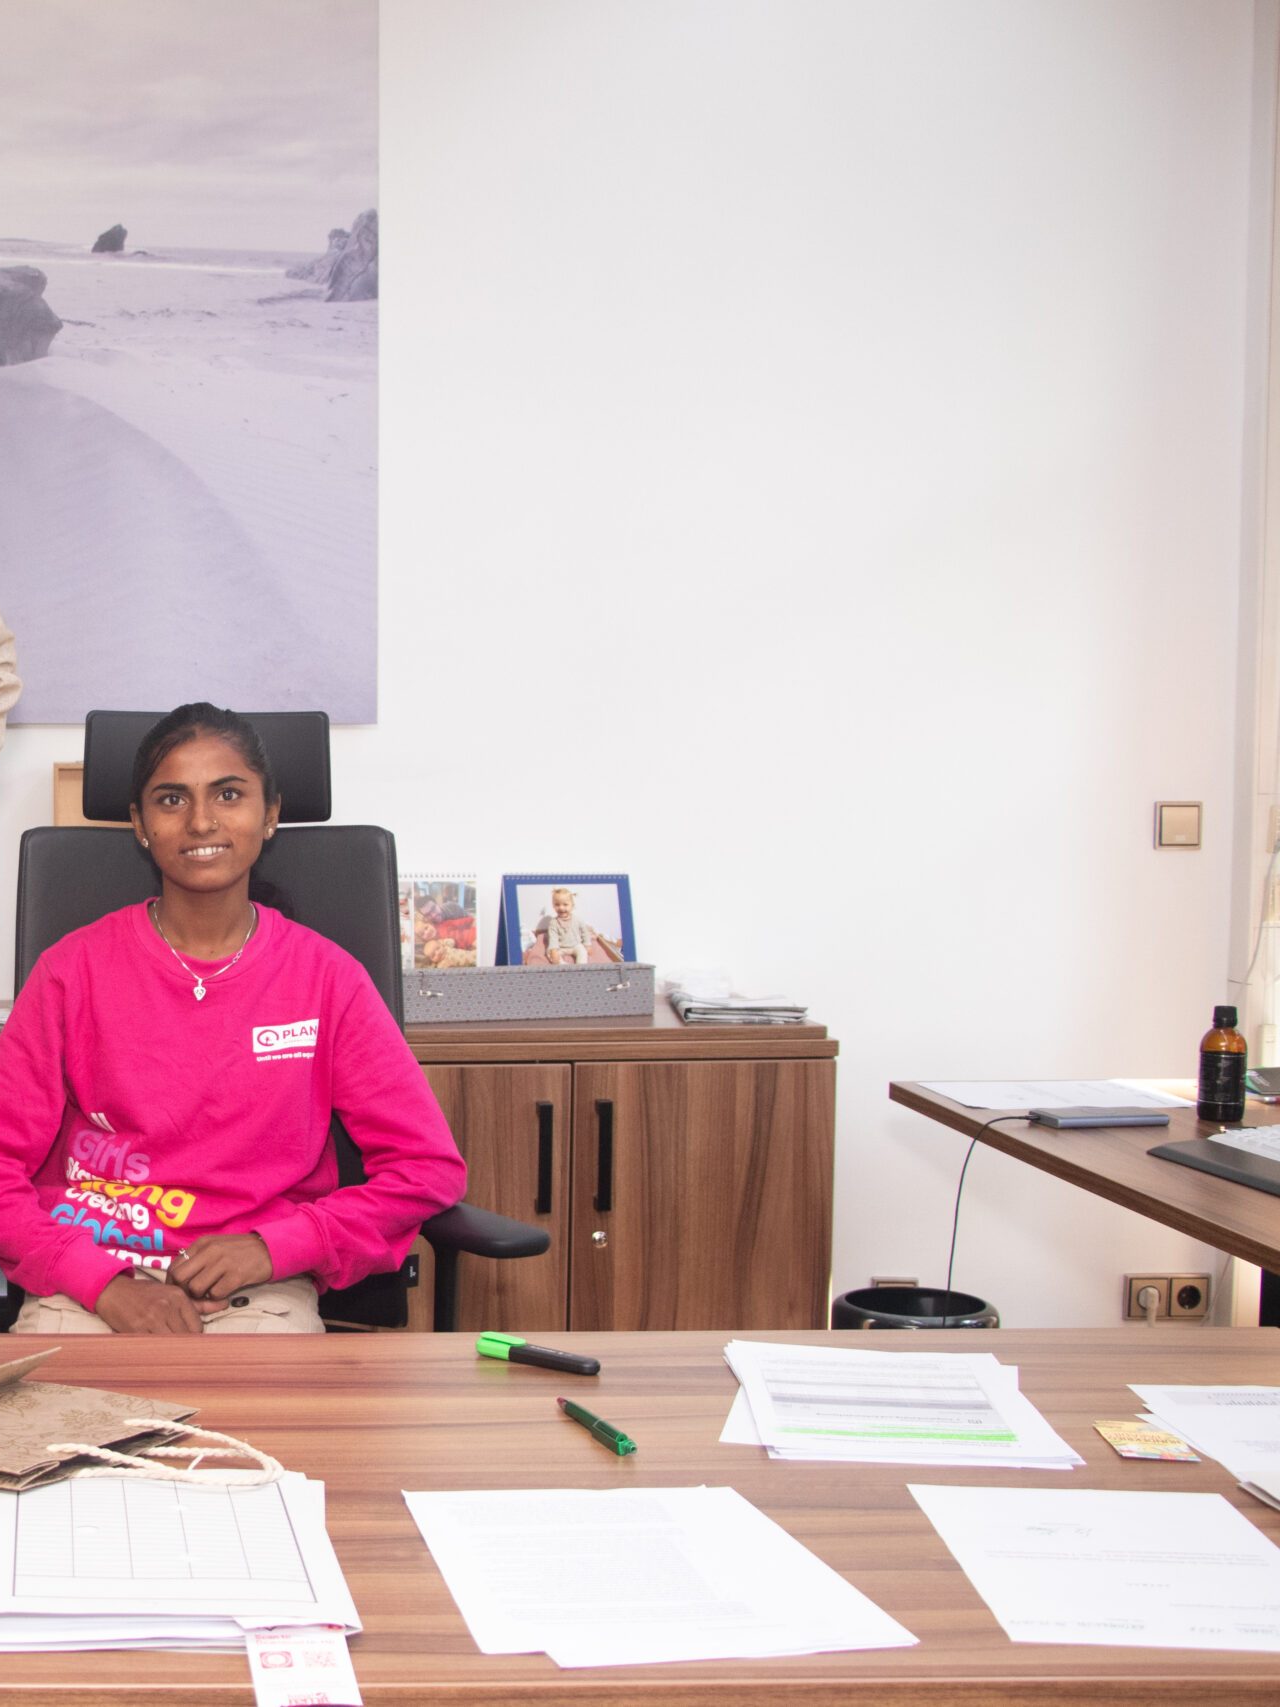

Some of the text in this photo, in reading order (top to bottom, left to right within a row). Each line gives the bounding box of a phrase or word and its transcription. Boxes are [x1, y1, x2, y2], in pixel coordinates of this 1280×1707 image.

[282, 1025, 317, 1039] PLAN
[256, 1054, 272, 1062] Until
[302, 1052, 315, 1060] equ
[73, 1129, 151, 1182] Girls
[65, 1187, 150, 1230] Creang
[80, 1181, 196, 1228] rong
